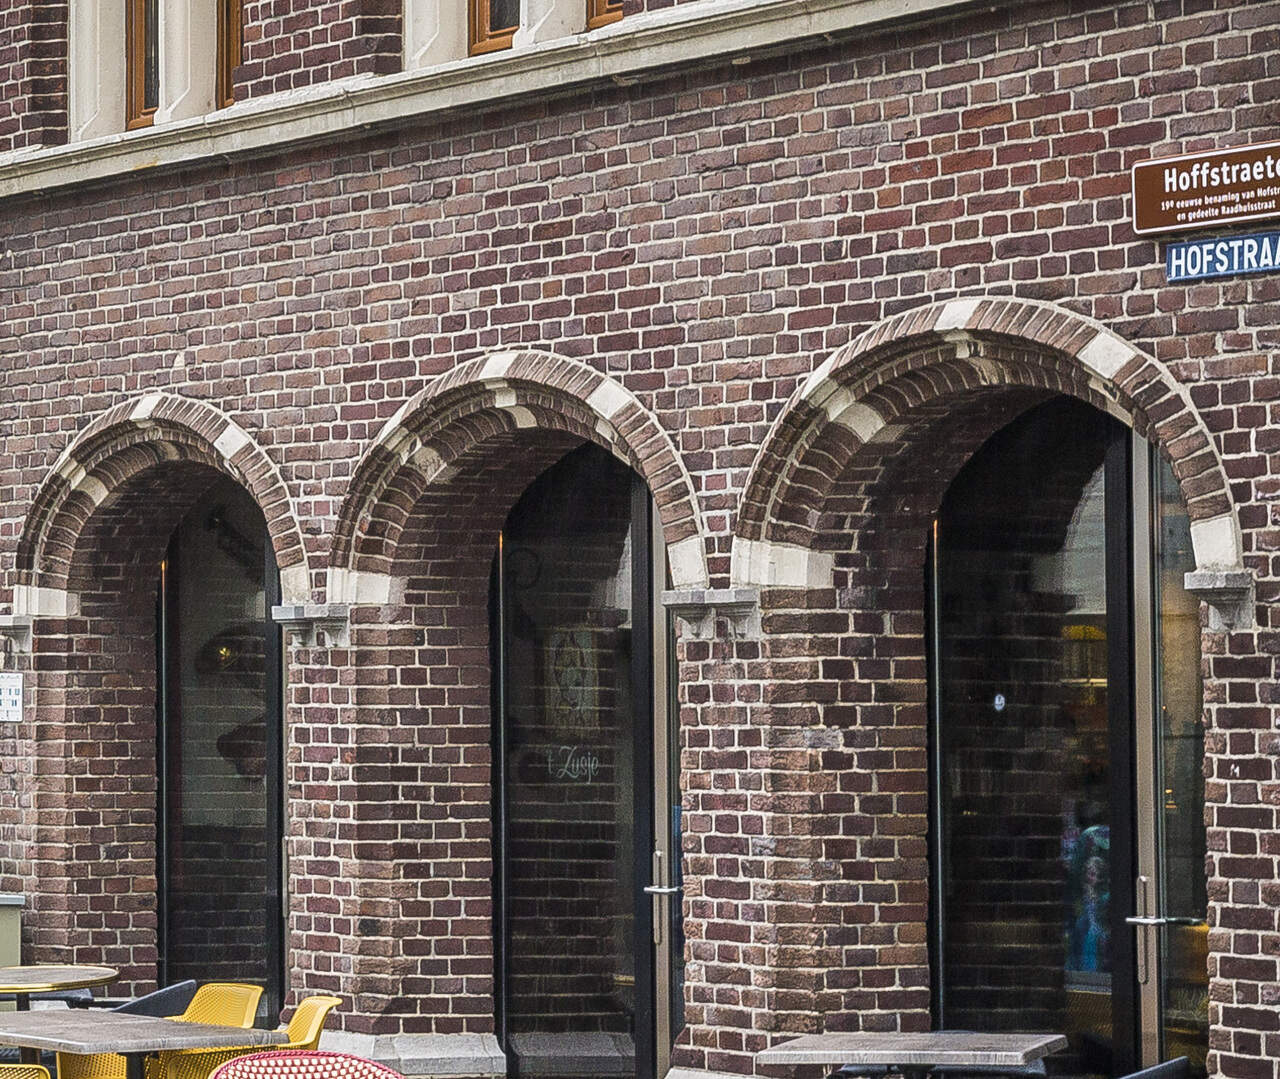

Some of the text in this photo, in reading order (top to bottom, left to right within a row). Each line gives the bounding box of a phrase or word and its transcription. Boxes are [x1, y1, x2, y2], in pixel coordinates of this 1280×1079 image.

[1176, 198, 1203, 209] eeuwse
[1204, 191, 1240, 205] benaming
[1241, 191, 1255, 200] van
[1256, 185, 1280, 198] Hofstr
[1176, 199, 1276, 222] en gedeelte Raadhuisstraat
[555, 745, 600, 785] Zusje
